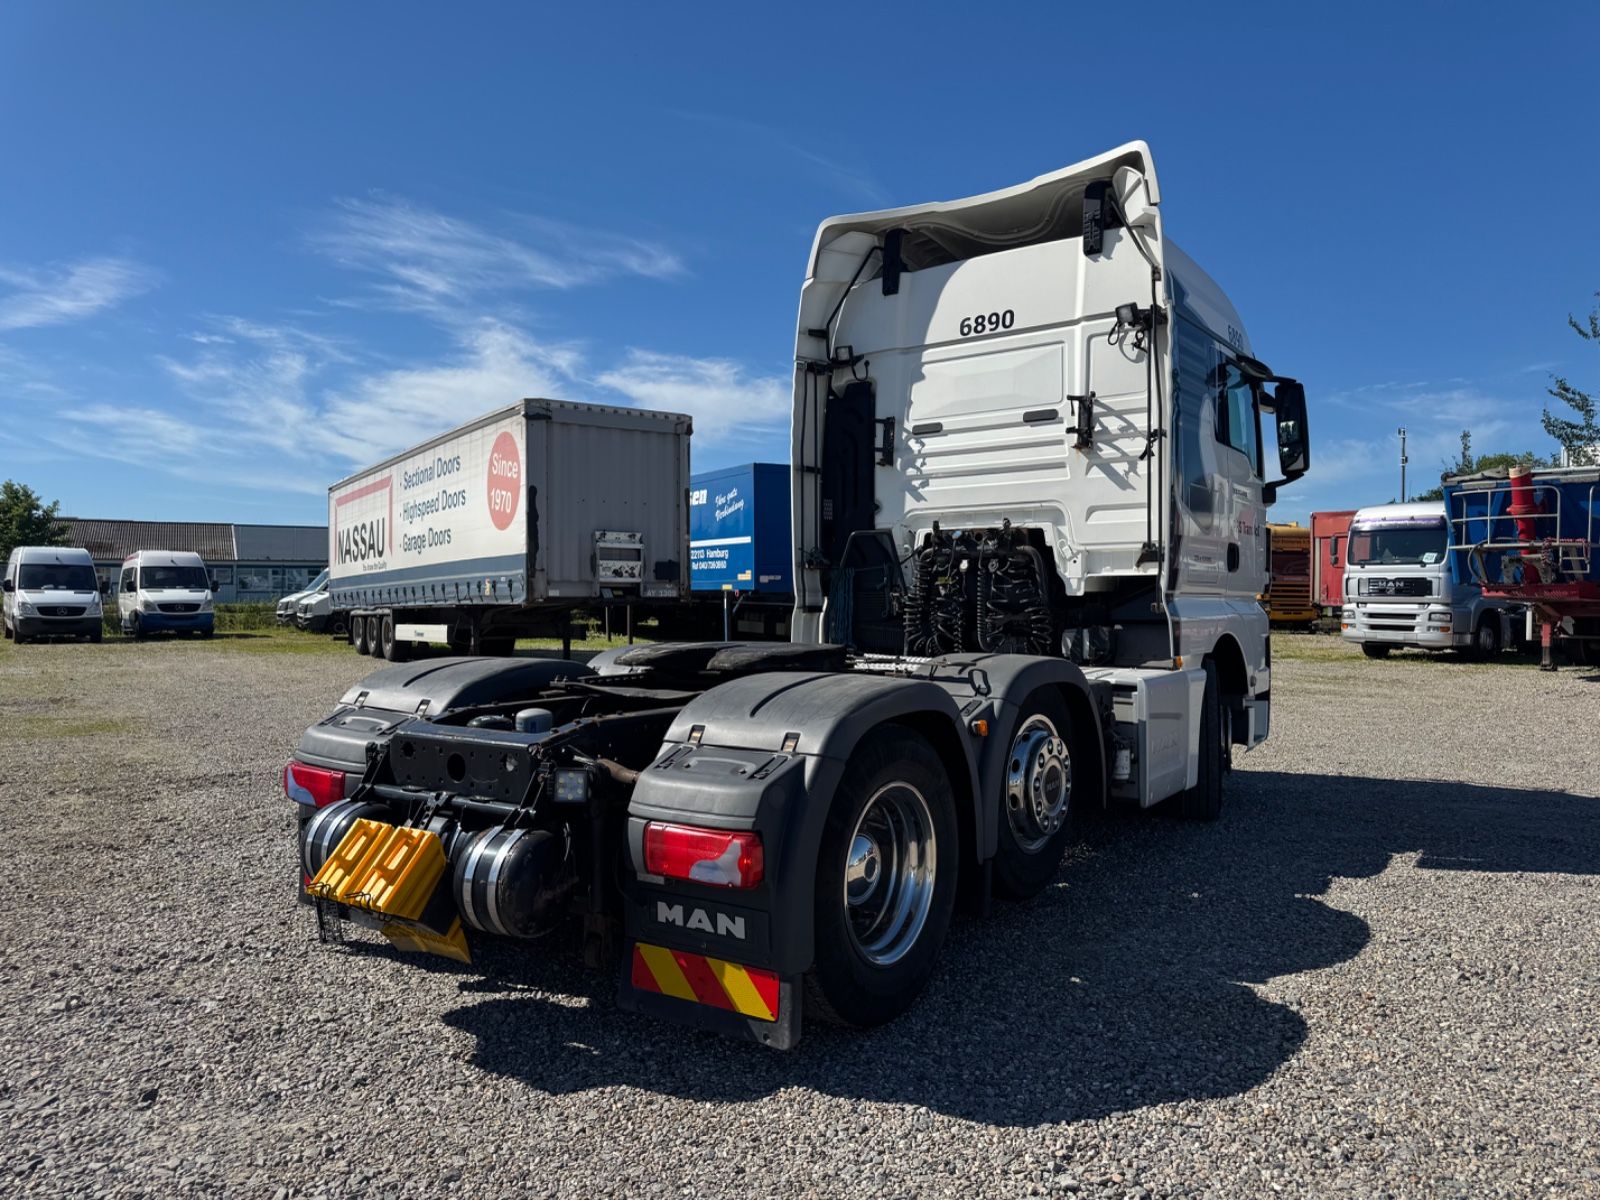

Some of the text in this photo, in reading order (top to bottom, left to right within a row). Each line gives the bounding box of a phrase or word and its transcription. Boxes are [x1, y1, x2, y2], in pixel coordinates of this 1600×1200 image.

[959, 309, 1015, 336] 6890
[403, 455, 461, 490] Sectional Doors
[491, 452, 519, 479] Since
[402, 489, 466, 524] Highspeed Doors
[490, 490, 512, 513] 1970
[337, 517, 386, 565] NASSAU
[402, 527, 452, 555] Garage Doors
[706, 548, 729, 560] Hamburg
[656, 901, 746, 940] MAN
